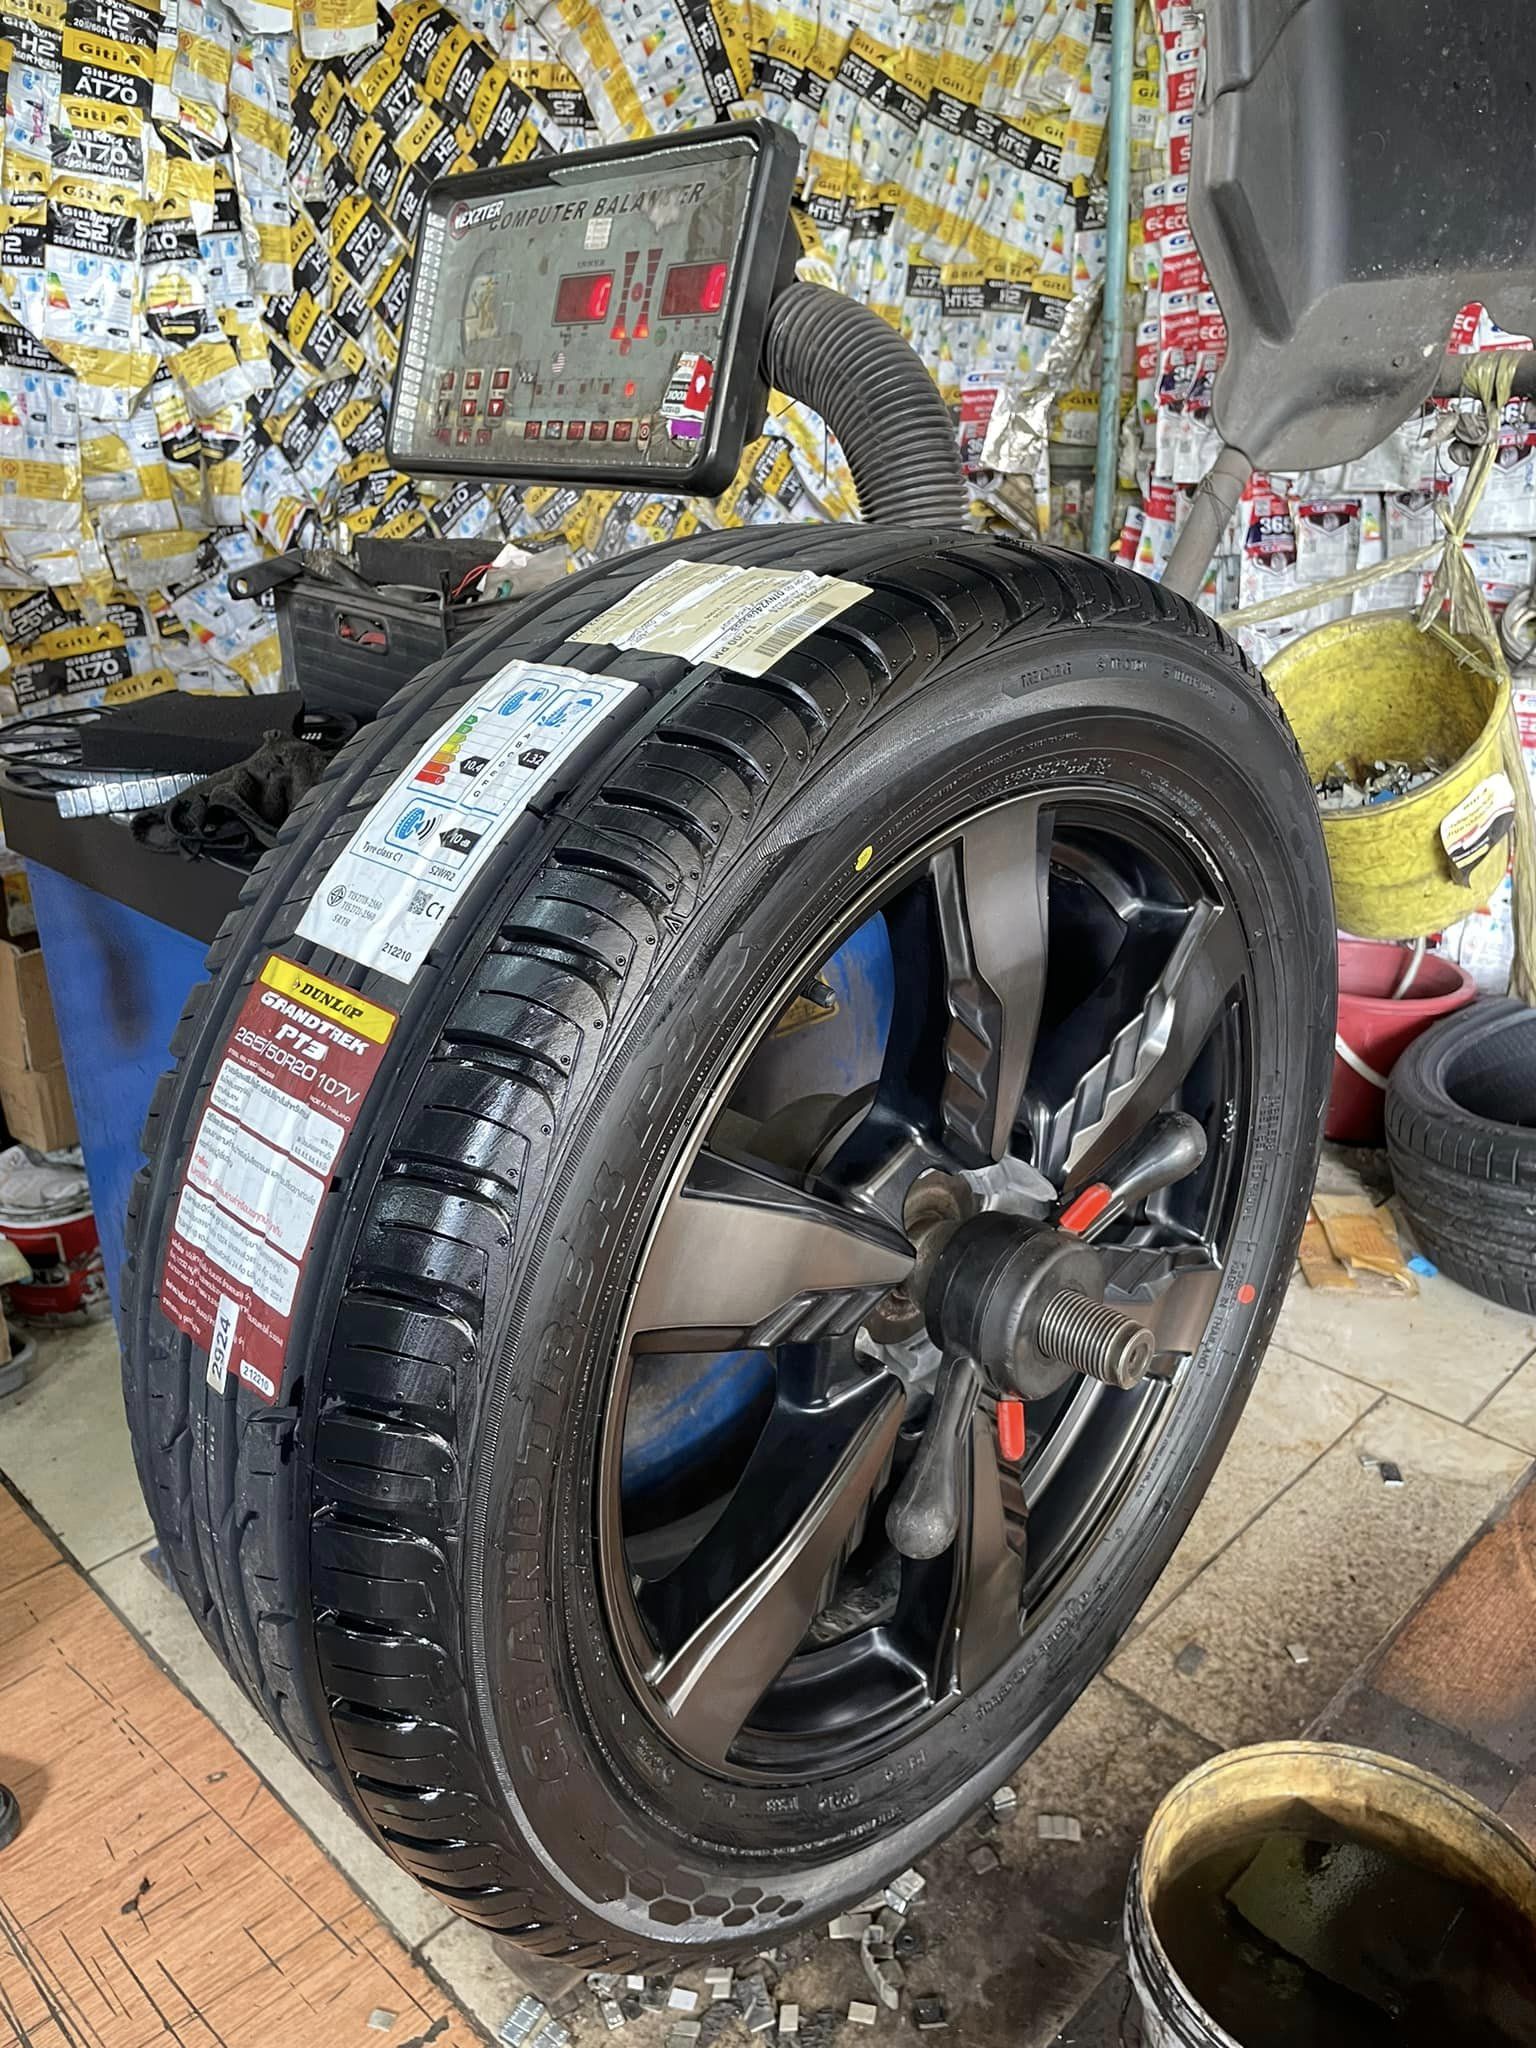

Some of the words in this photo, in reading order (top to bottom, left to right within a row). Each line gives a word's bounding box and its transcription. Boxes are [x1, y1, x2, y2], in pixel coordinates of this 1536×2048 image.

[96, 6, 130, 31] H2
[397, 15, 414, 46] Giti
[21, 33, 57, 58] H2
[416, 27, 437, 57] H2
[697, 22, 714, 50] H2
[79, 43, 118, 61] Giti
[778, 44, 801, 60] Giti
[366, 69, 388, 97] Giti
[434, 57, 451, 86] Giti
[455, 68, 475, 99] H2
[773, 69, 797, 92] H2
[905, 73, 927, 90] Giti
[75, 76, 138, 104] AT70
[942, 76, 972, 95] Giti
[68, 106, 105, 122] Giti
[552, 100, 576, 115] S2
[940, 103, 961, 124] S2
[412, 117, 435, 145] Giti
[496, 106, 515, 137] H2
[976, 120, 995, 139] S2
[66, 140, 128, 165] AT70
[434, 133, 457, 163] H2
[372, 163, 391, 191] H2
[819, 180, 841, 191] Giti
[401, 192, 418, 221] H2
[351, 222, 381, 267] AT70
[294, 306, 311, 336] Giti
[56, 637, 91, 650] Giti
[66, 659, 119, 684] AT70
[114, 683, 144, 698] Giti
[362, 841, 376, 854] Tyre
[376, 847, 393, 860] class
[425, 901, 446, 920] C1
[382, 942, 412, 962] 212210
[300, 983, 364, 1019] DUNLOP
[260, 990, 370, 1056] GRANDTREK
[275, 1023, 329, 1061] PT3
[234, 1026, 318, 1081] 265/50R20
[318, 1073, 360, 1105] 107V
[211, 1319, 231, 1379] 2924
[242, 1367, 269, 1392] 212210
